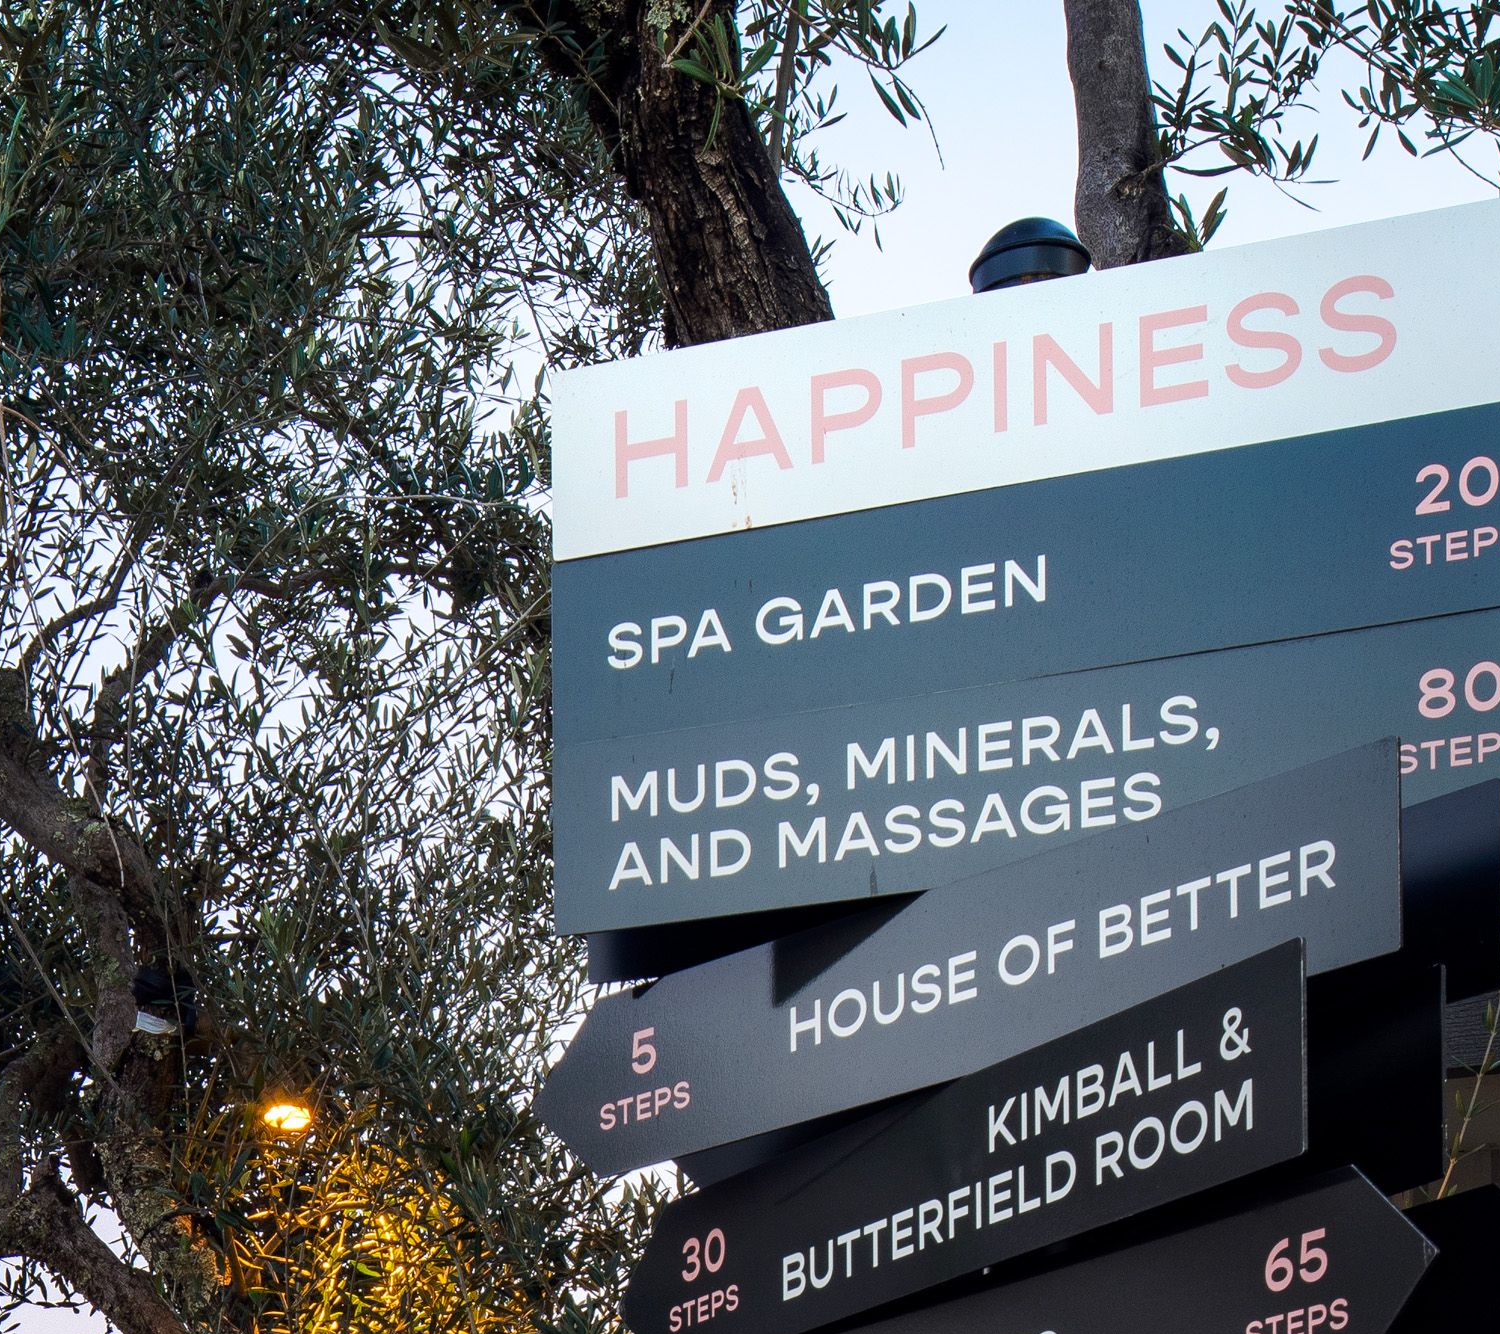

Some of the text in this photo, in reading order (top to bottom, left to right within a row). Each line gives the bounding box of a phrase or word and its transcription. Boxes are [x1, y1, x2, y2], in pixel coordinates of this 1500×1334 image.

[616, 276, 1396, 498] HAPPINESS
[1416, 456, 1499, 515] 20
[608, 555, 1045, 669] SPA GARDEN
[612, 696, 1219, 821] MUDS, MINERALS,
[609, 773, 1161, 890] AND MASSAGES
[790, 841, 1335, 1052] HOUSE OF BETTER
[600, 1081, 690, 1130] STEPS
[632, 1027, 656, 1074] 5
[989, 1007, 1251, 1153] KIMBALL &
[783, 1079, 1252, 1301] BUTTERFIELD ROOM
[670, 1285, 738, 1332] STEPS
[682, 1228, 725, 1281] 30
[1265, 1228, 1327, 1291] 65
